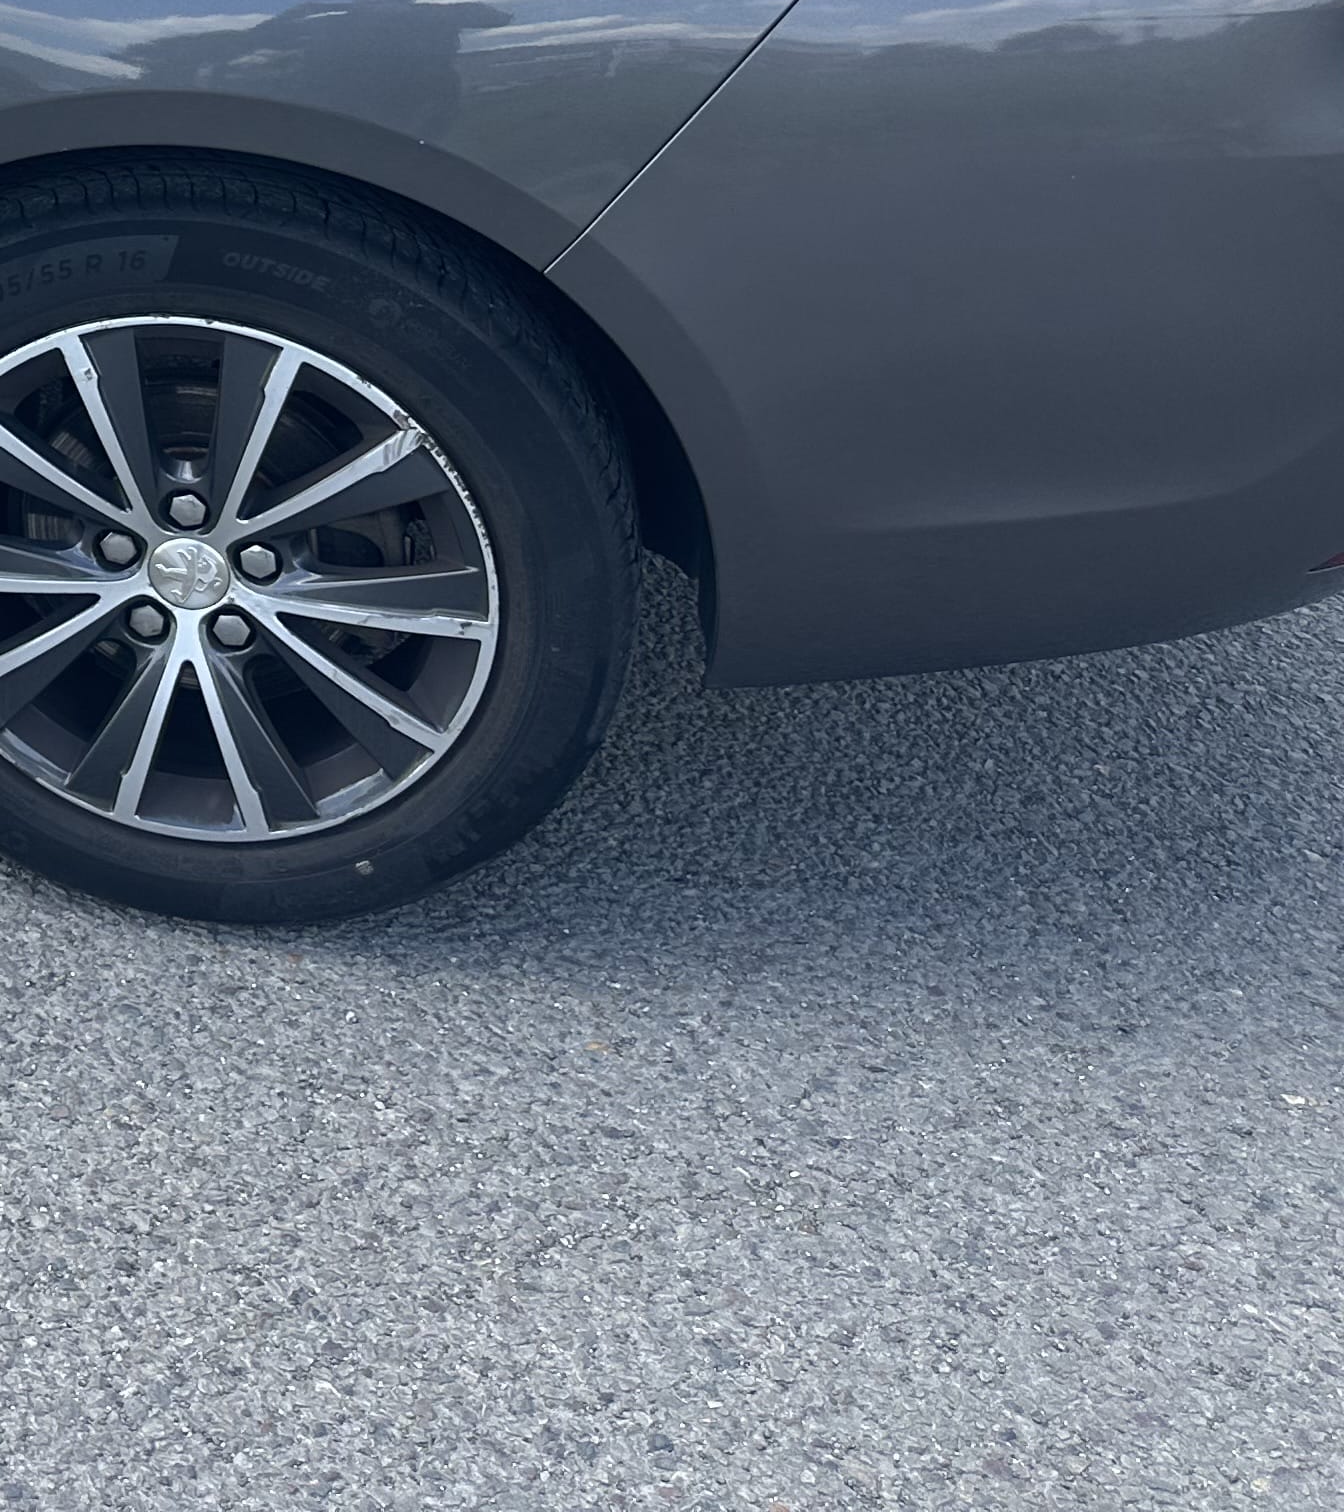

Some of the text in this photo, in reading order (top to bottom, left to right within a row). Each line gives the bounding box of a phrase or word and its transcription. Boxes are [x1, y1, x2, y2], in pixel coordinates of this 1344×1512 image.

[85, 253, 103, 274] R
[118, 249, 147, 272] 16
[221, 251, 333, 294] OUTSIDE
